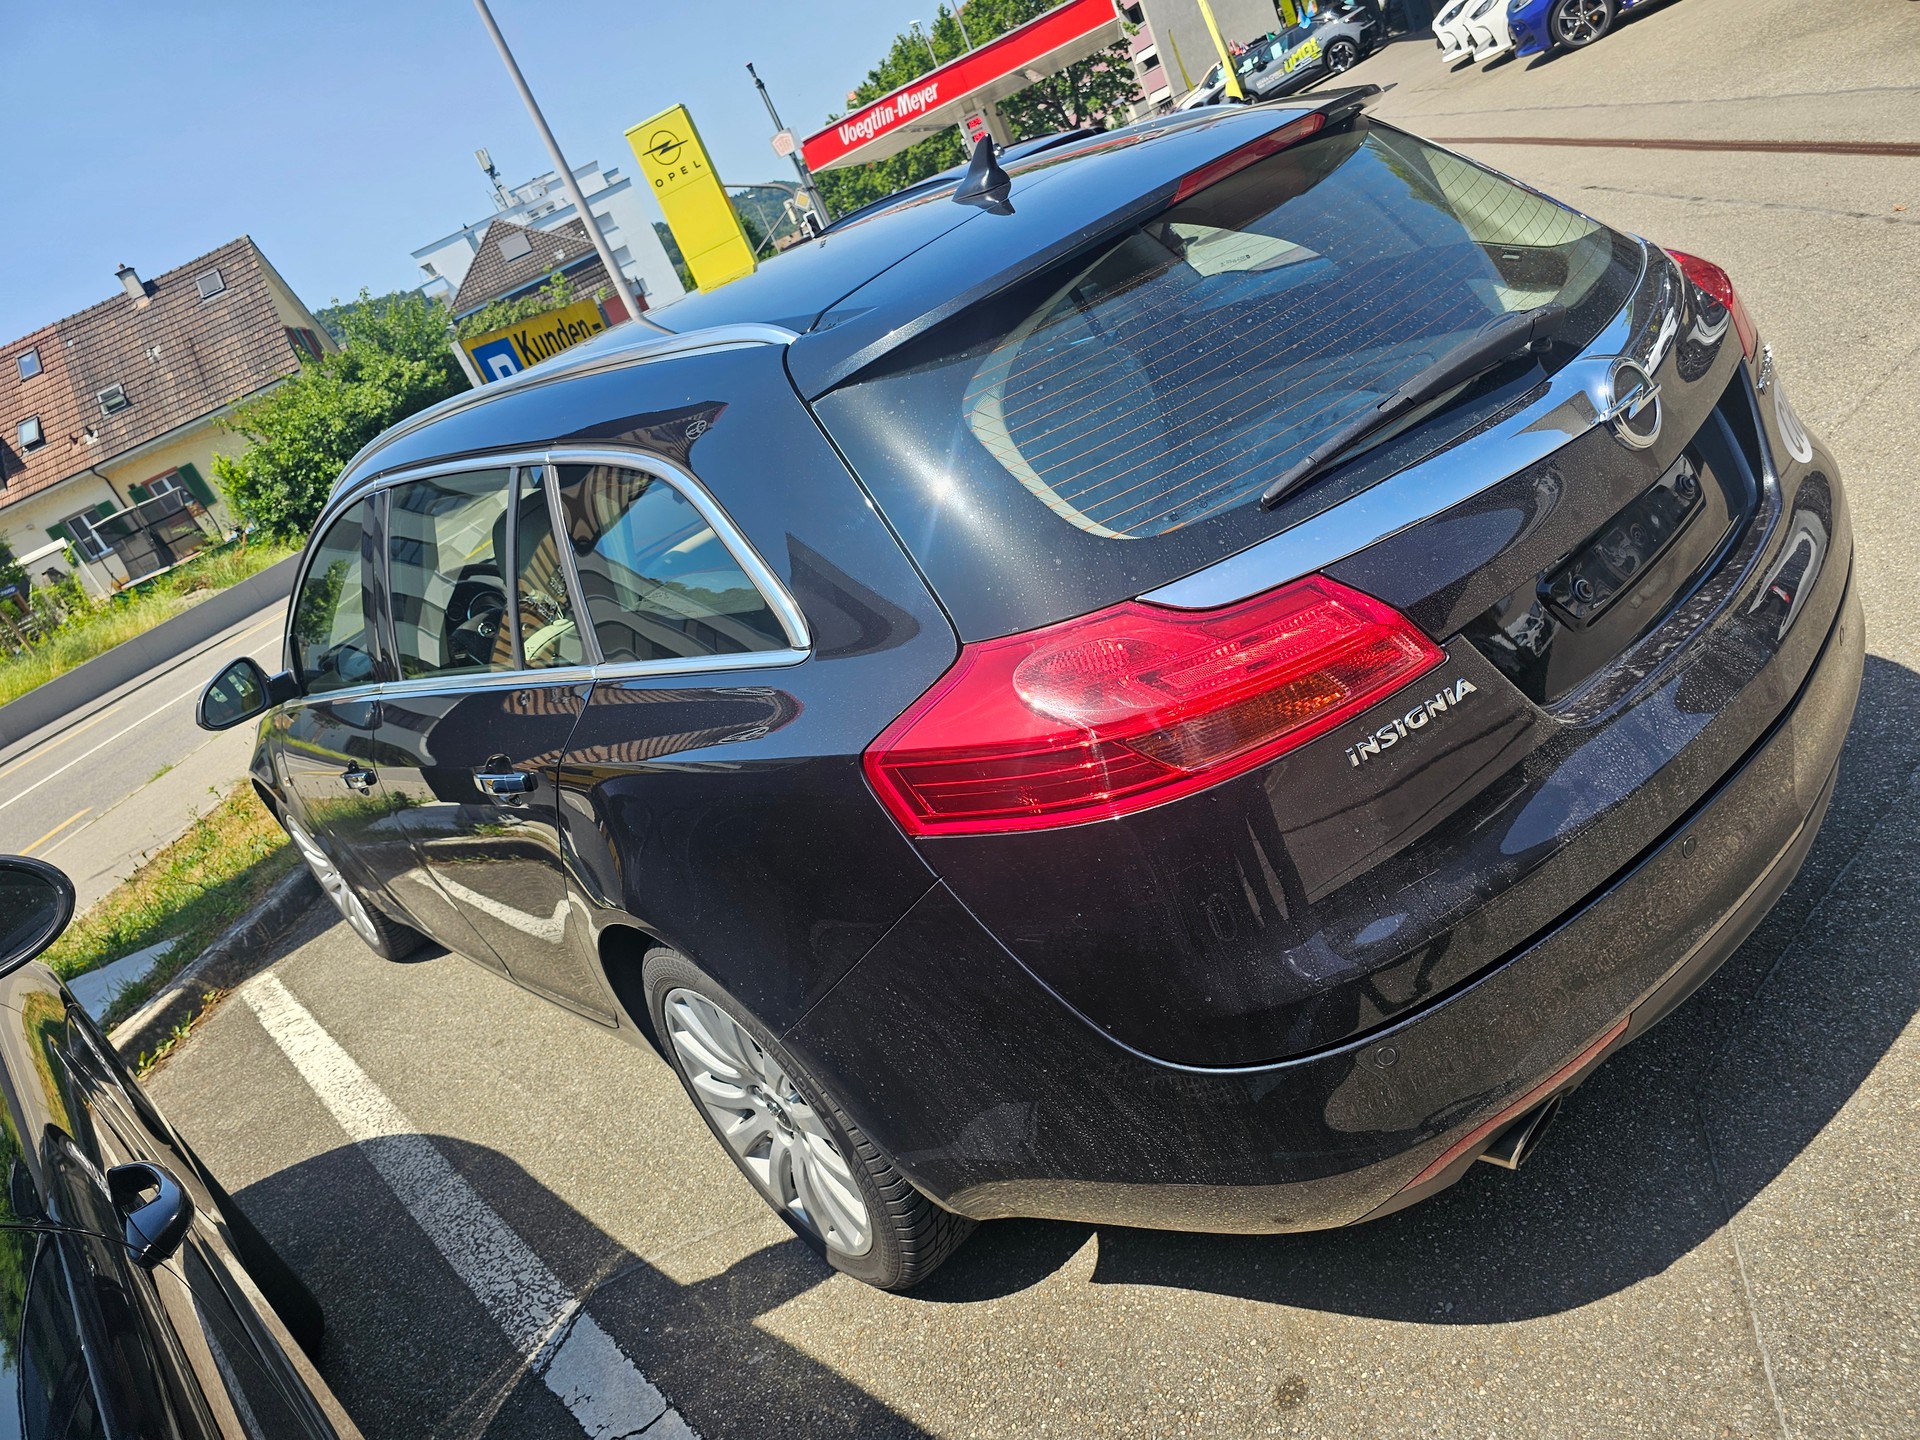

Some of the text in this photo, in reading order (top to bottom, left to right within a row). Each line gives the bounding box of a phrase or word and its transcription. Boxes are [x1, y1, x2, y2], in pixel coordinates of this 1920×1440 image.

[838, 83, 938, 146] Voegtlin-Meyer
[655, 160, 701, 188] OPEL
[1344, 677, 1478, 768] INSIGNIA
